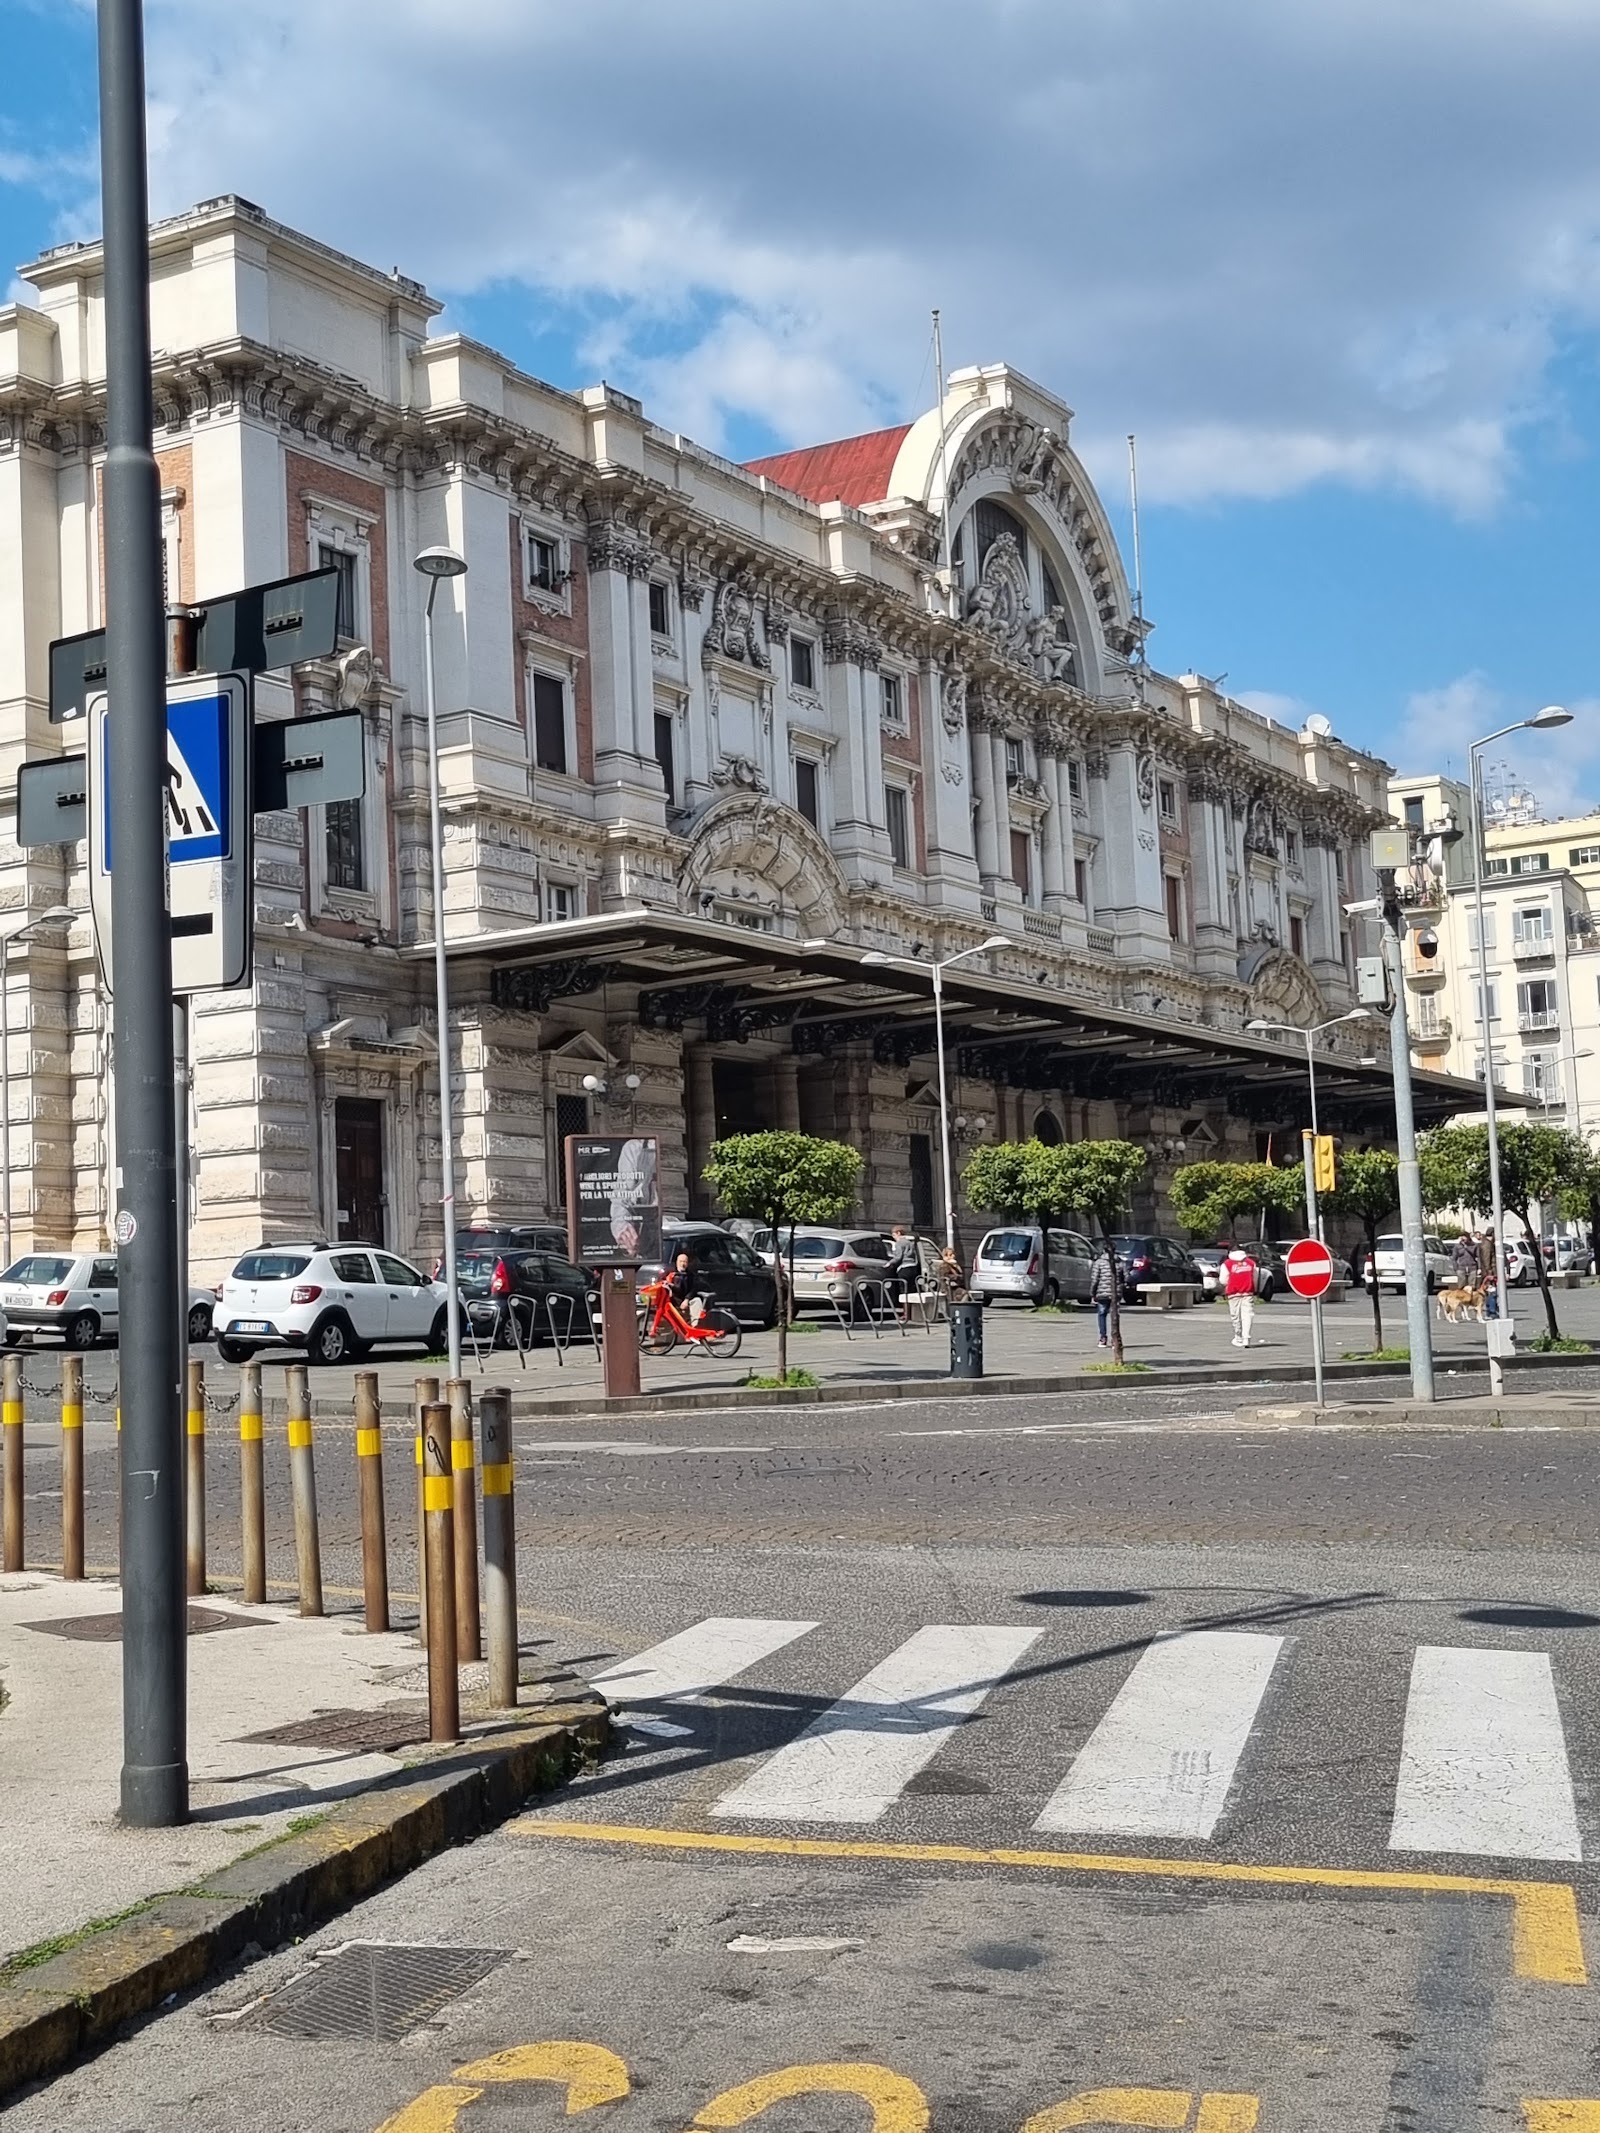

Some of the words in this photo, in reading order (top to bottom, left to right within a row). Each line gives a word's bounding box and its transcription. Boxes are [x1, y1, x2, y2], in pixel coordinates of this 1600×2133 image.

[584, 1172, 612, 1180] MIGLIORI
[613, 1172, 644, 1180] PRODOTTI
[580, 1182, 595, 1190] WINE
[596, 1182, 601, 1190] &
[602, 1182, 627, 1190] SPIRITS
[580, 1191, 593, 1200] PER
[594, 1191, 602, 1199] LA
[603, 1191, 616, 1199] TUA
